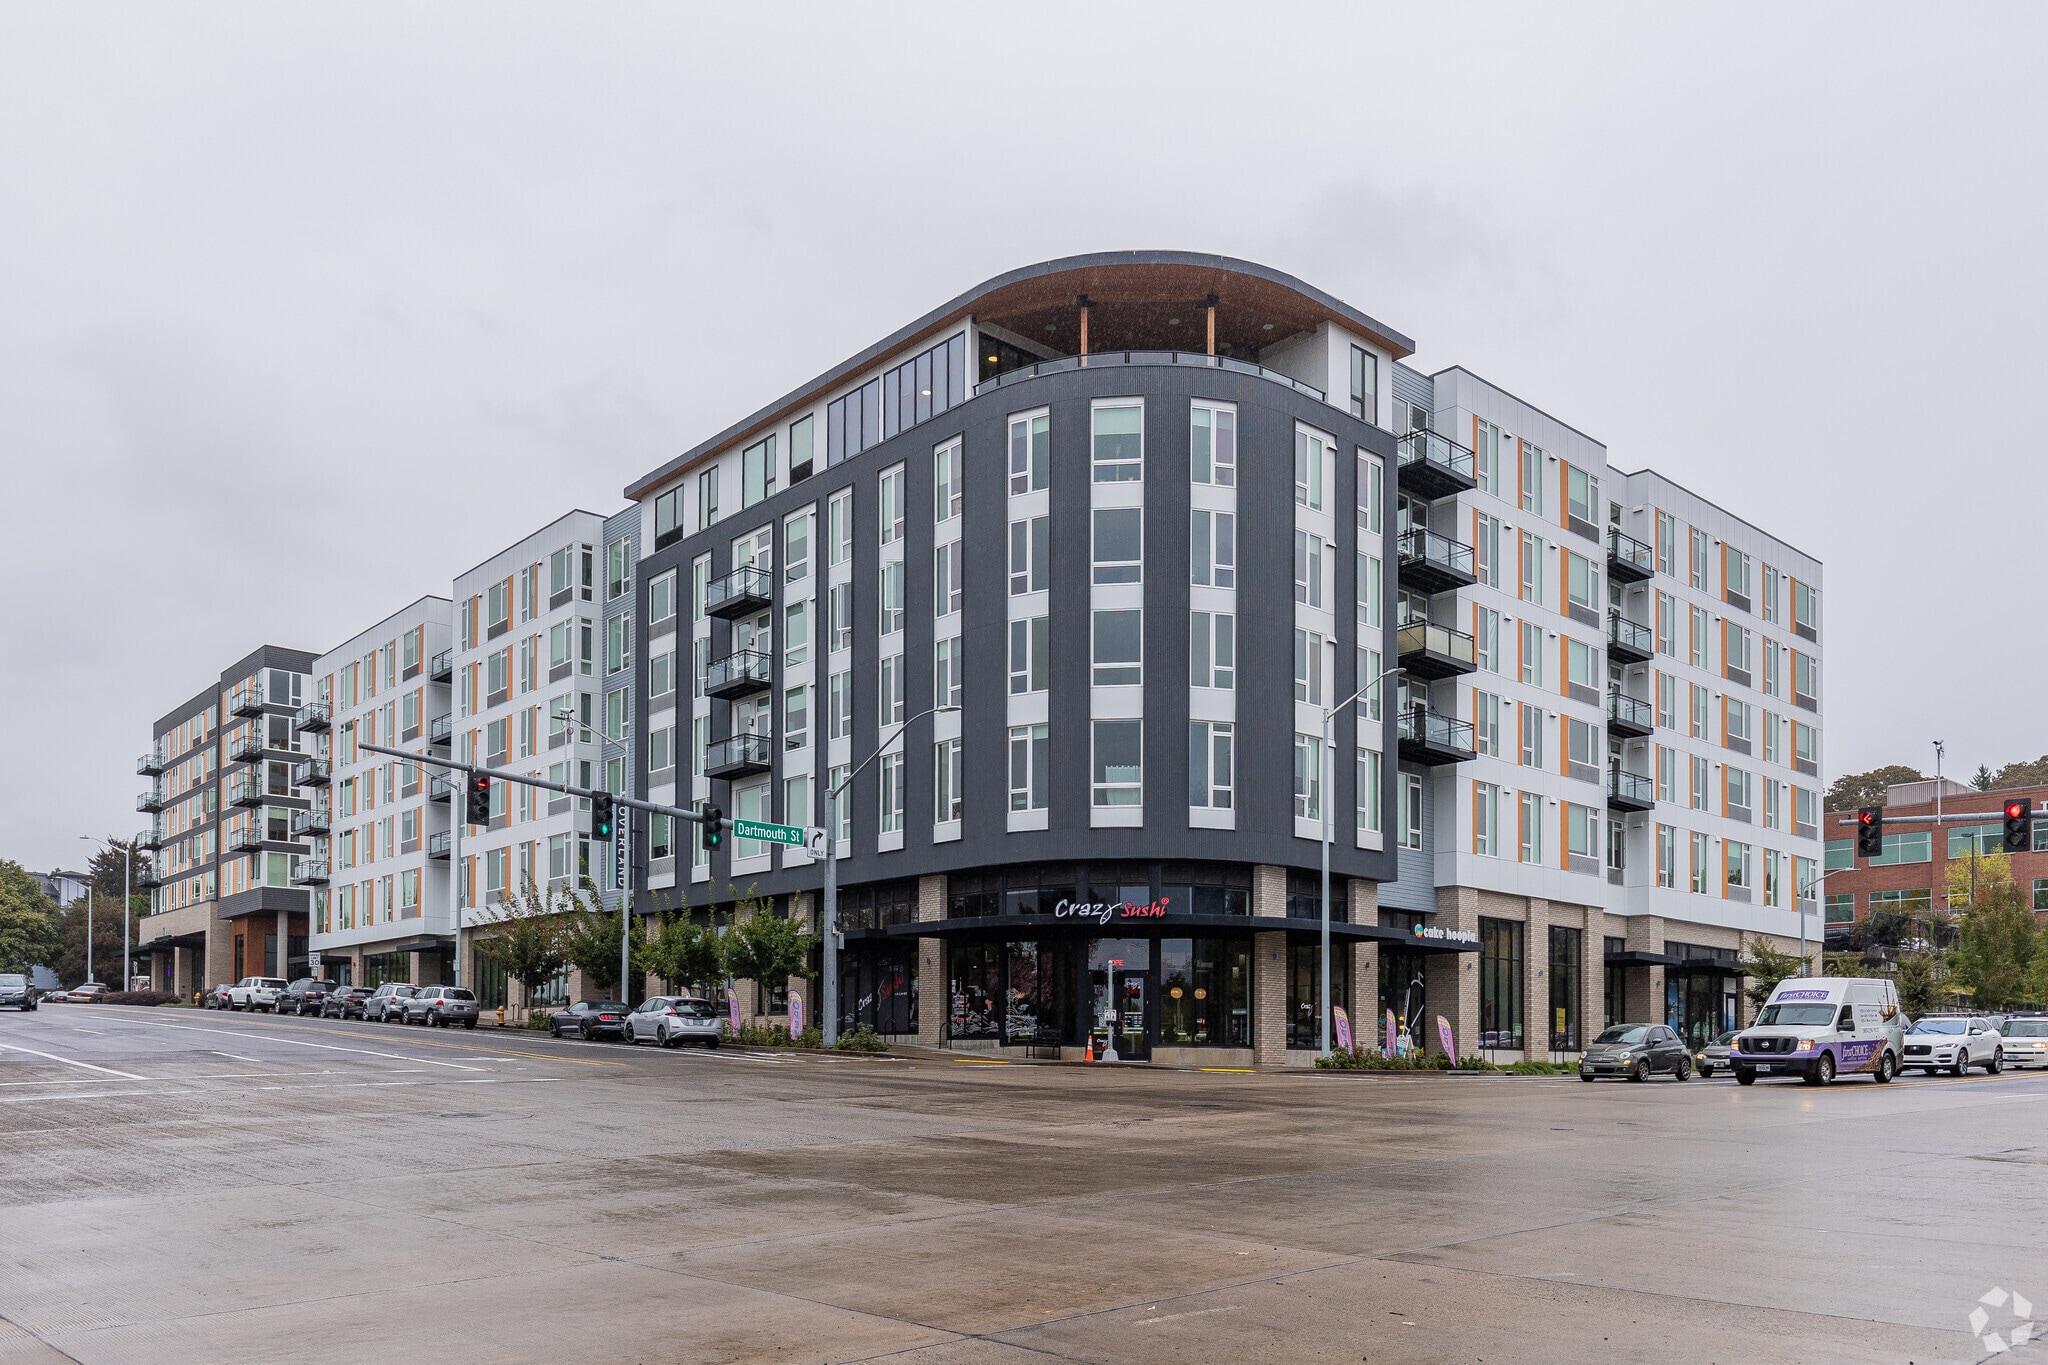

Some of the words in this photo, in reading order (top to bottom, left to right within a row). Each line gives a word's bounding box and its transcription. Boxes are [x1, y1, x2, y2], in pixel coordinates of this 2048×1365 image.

[738, 822, 787, 841] Dartmouth
[791, 829, 800, 842] St
[810, 848, 825, 857] ONLY
[1055, 898, 1122, 925] Crazy
[1120, 896, 1170, 917] Sushi
[1423, 926, 1444, 939] cake
[1446, 927, 1476, 944] hoopla
